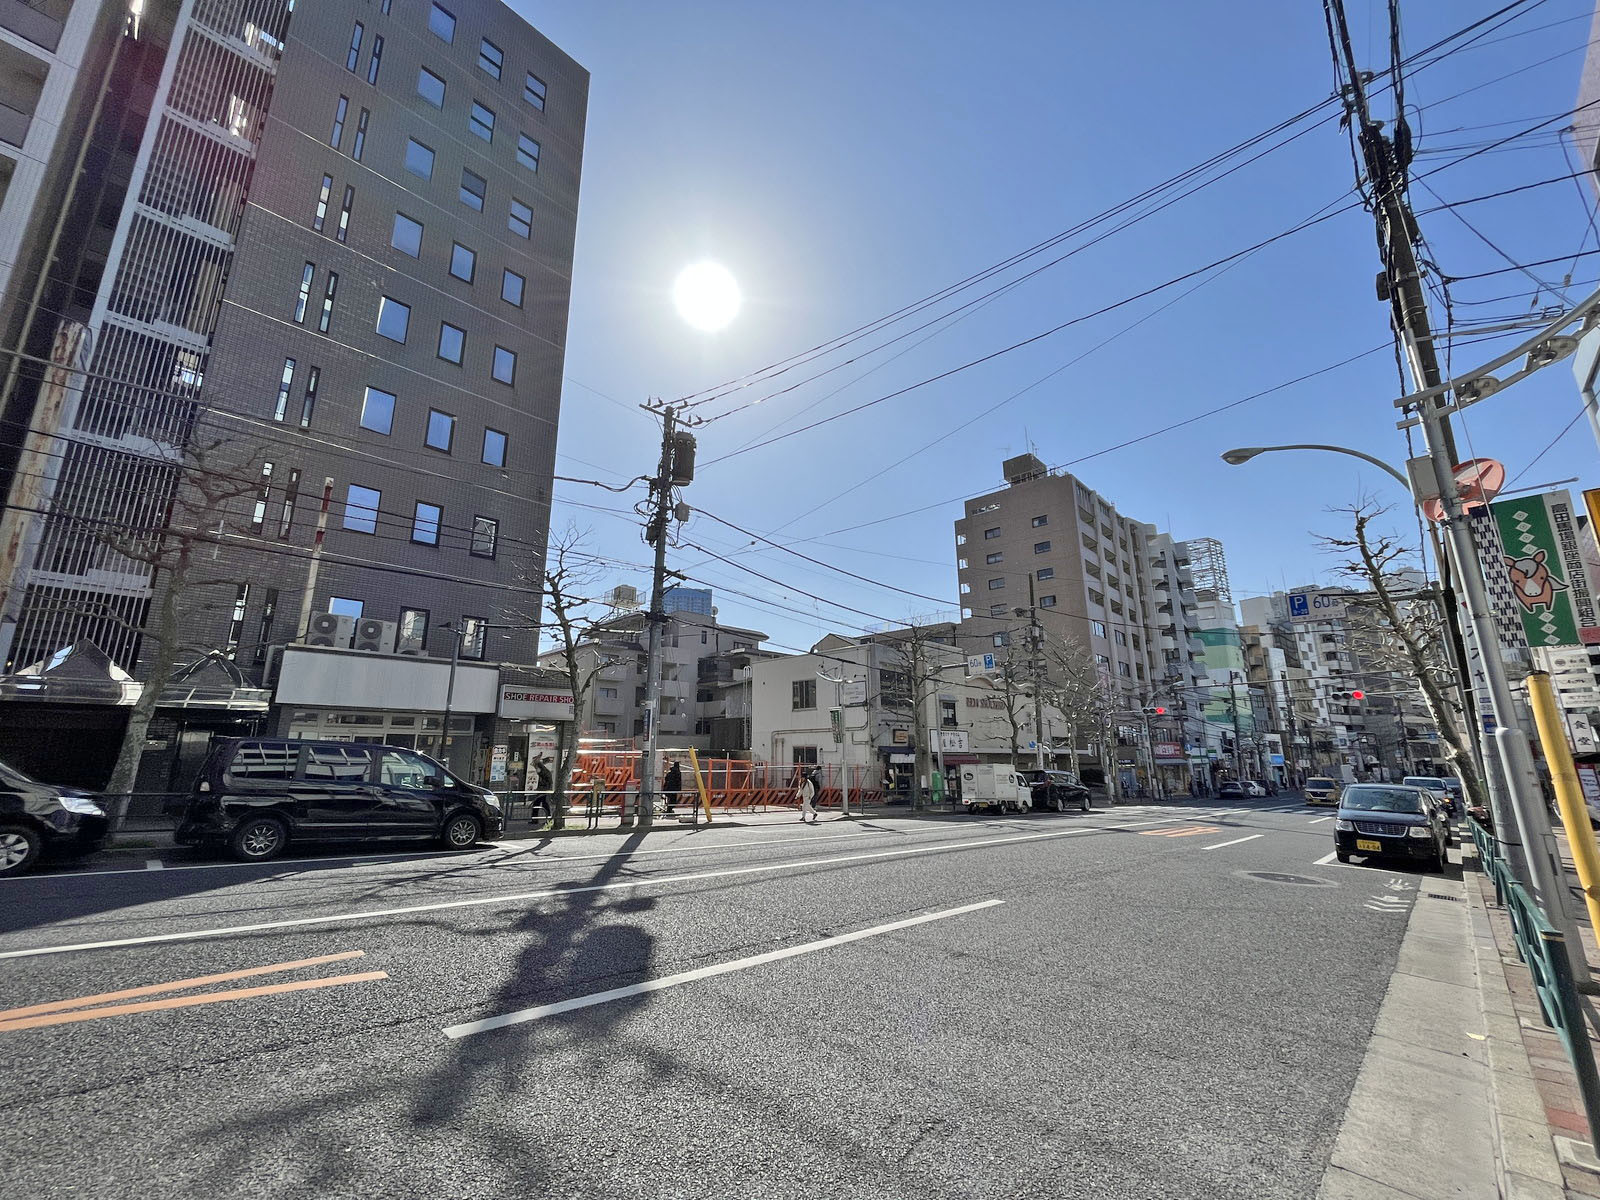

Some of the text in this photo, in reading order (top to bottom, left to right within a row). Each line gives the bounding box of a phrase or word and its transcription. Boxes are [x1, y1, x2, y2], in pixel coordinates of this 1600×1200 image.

[1294, 596, 1304, 609] P
[505, 692, 575, 704] SHOE REPAIR SHO
